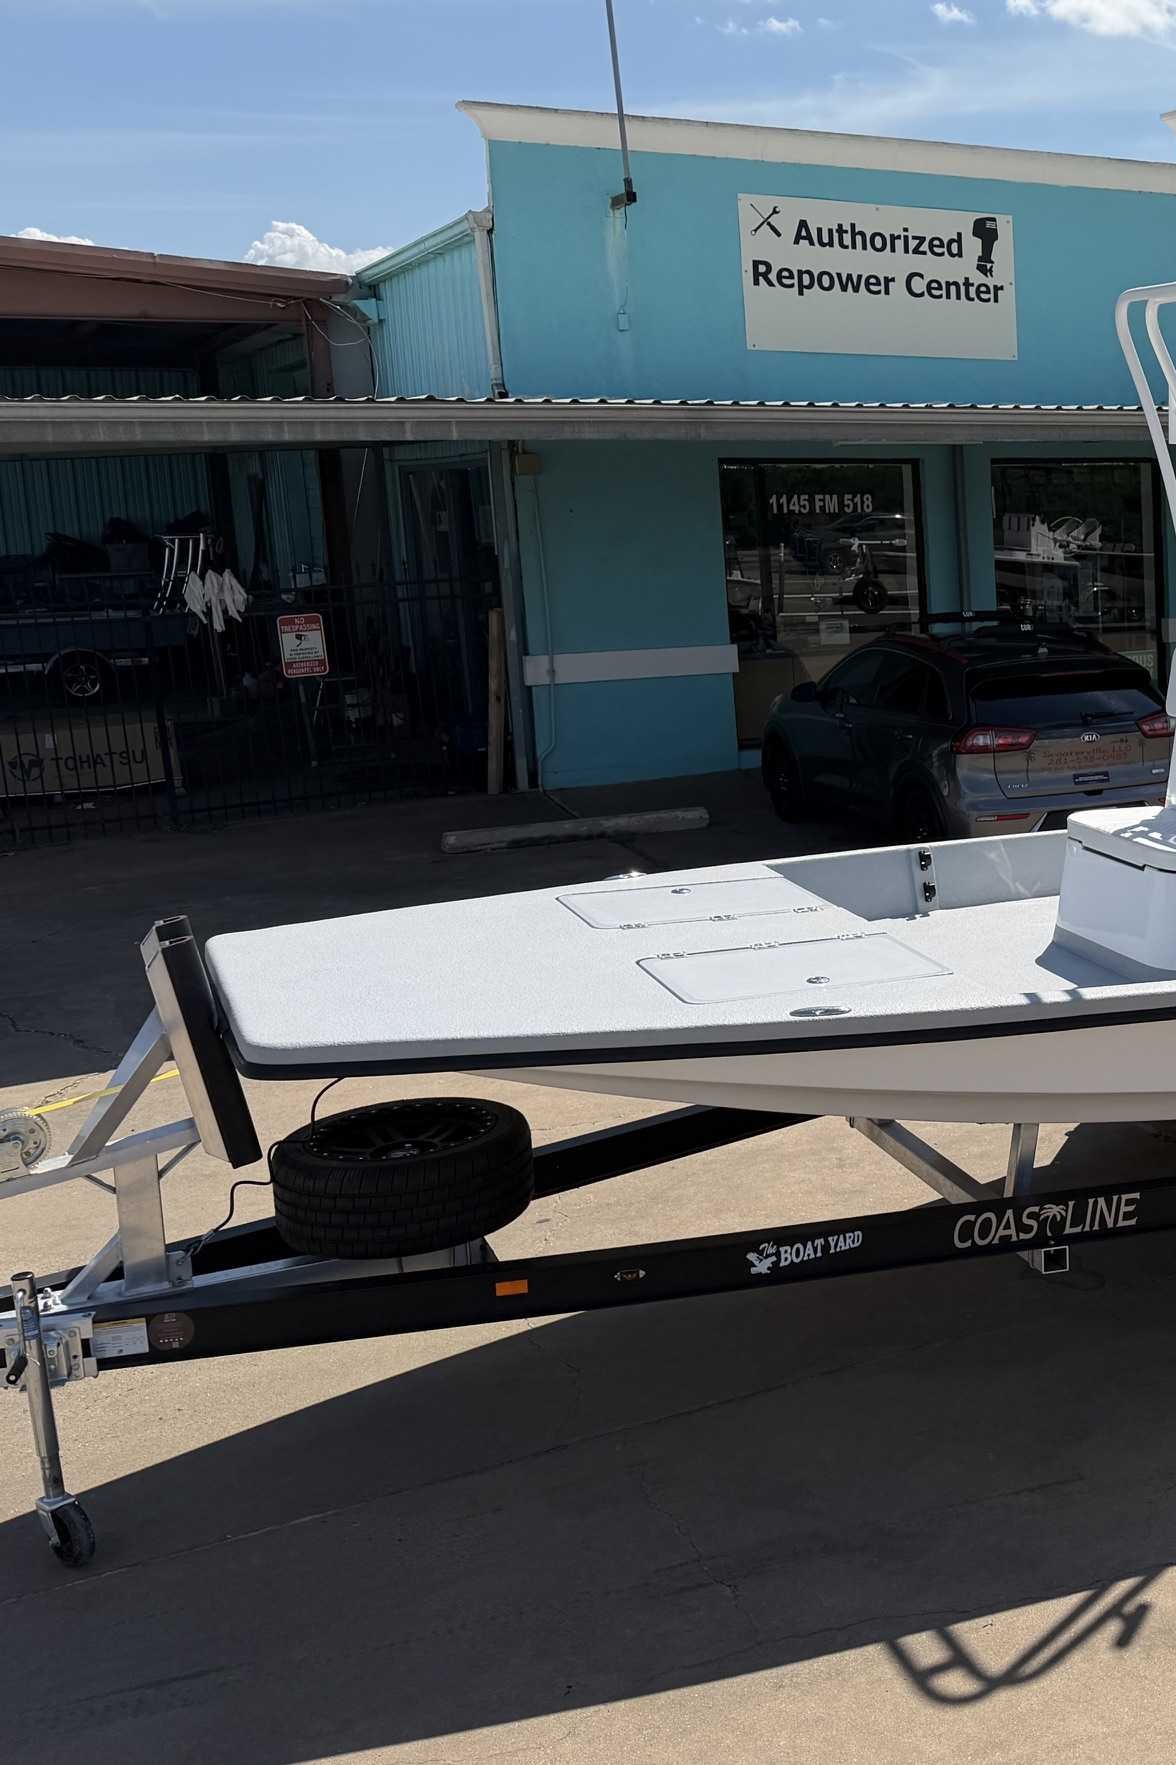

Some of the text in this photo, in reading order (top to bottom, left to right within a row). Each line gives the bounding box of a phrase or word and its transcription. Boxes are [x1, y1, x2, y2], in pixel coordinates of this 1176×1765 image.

[793, 219, 963, 258] Authorized
[752, 260, 1004, 303] Repower Center
[769, 493, 873, 514] 1145 FM 518
[294, 616, 305, 624] NO
[51, 750, 144, 771] TOHATSU
[759, 1241, 777, 1257] The
[779, 1230, 863, 1267] BOAT YARD
